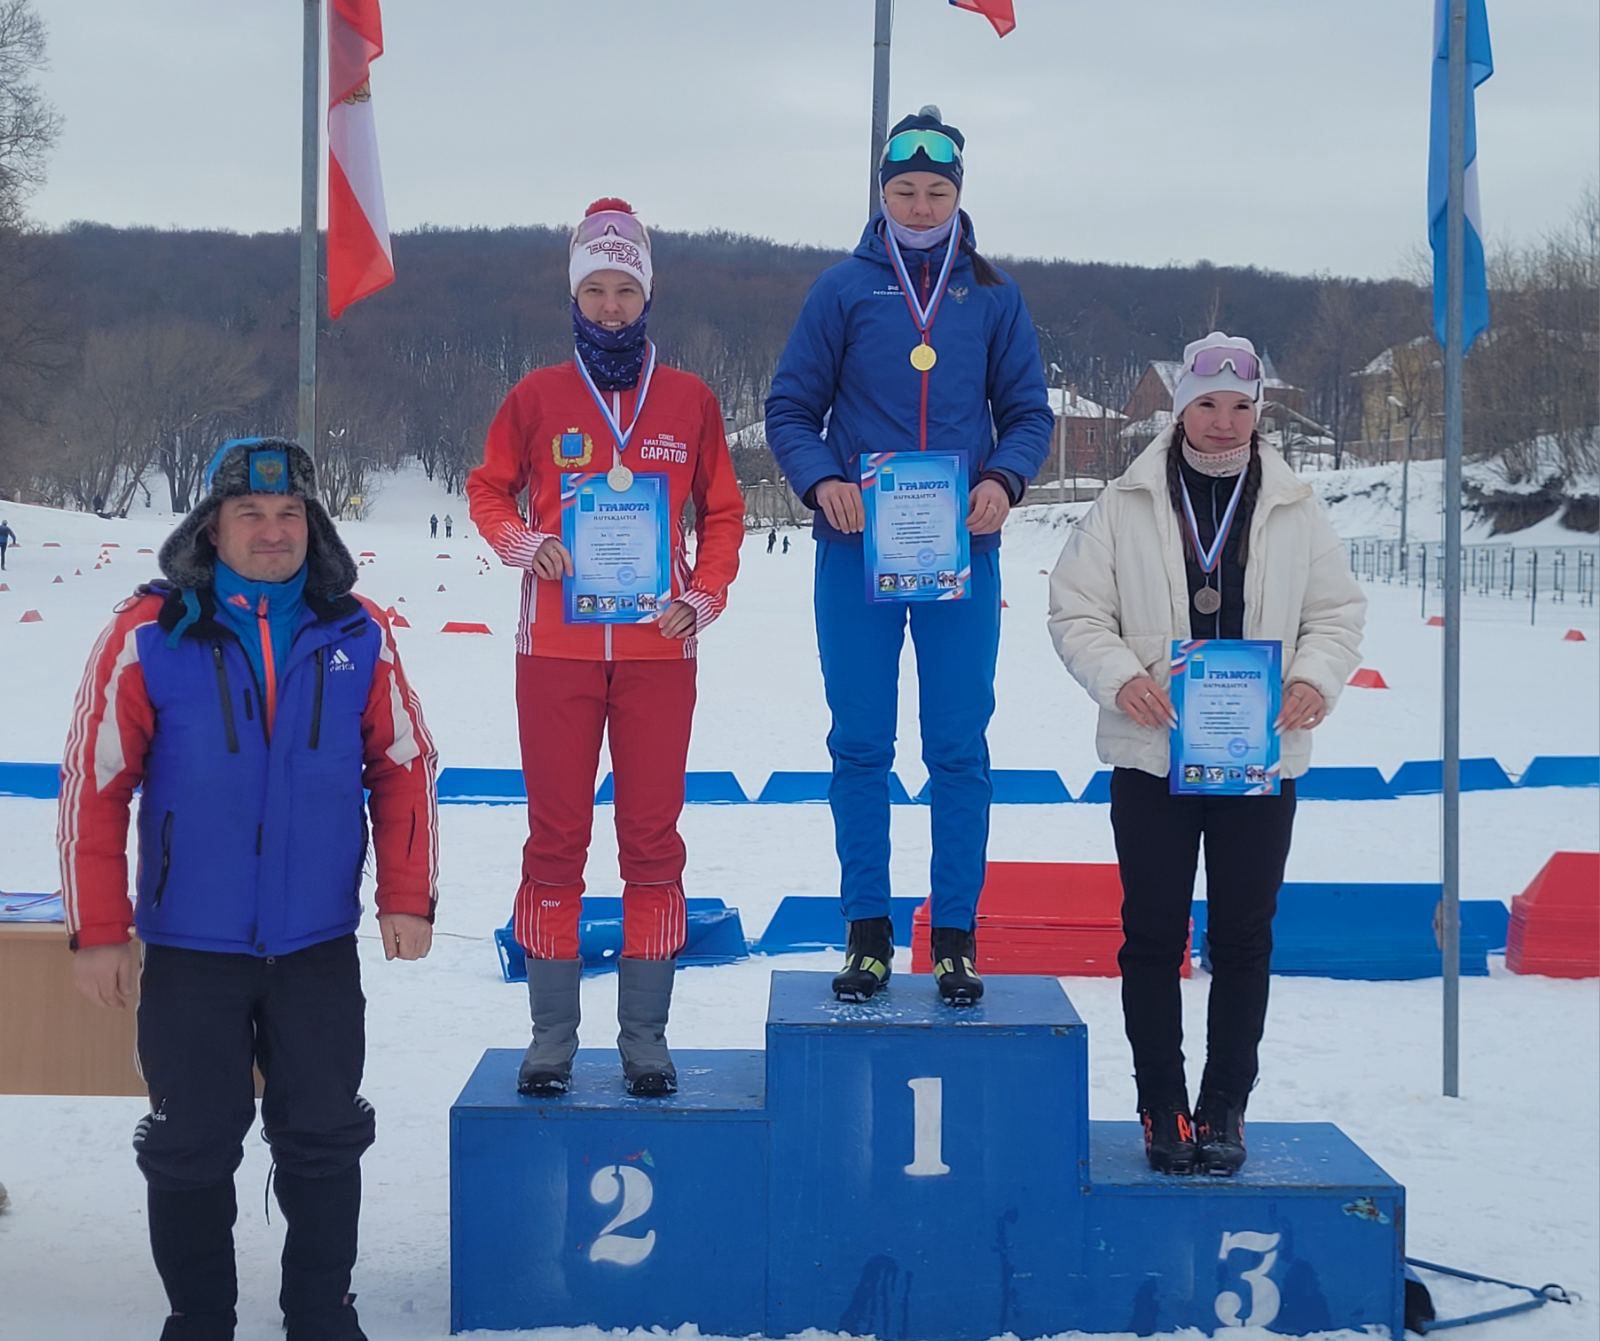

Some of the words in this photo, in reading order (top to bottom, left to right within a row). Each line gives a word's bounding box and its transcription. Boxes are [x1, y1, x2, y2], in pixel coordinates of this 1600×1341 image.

[604, 250, 645, 276] TEAM
[640, 446, 688, 464] САРАТОВ
[898, 480, 950, 491] ГРАМОТА
[598, 502, 650, 512] ГРАМОТА
[1208, 670, 1261, 680] ГРАМОТА
[904, 1077, 951, 1177] 1
[589, 1165, 657, 1265] 2
[1214, 1230, 1281, 1328] 3
